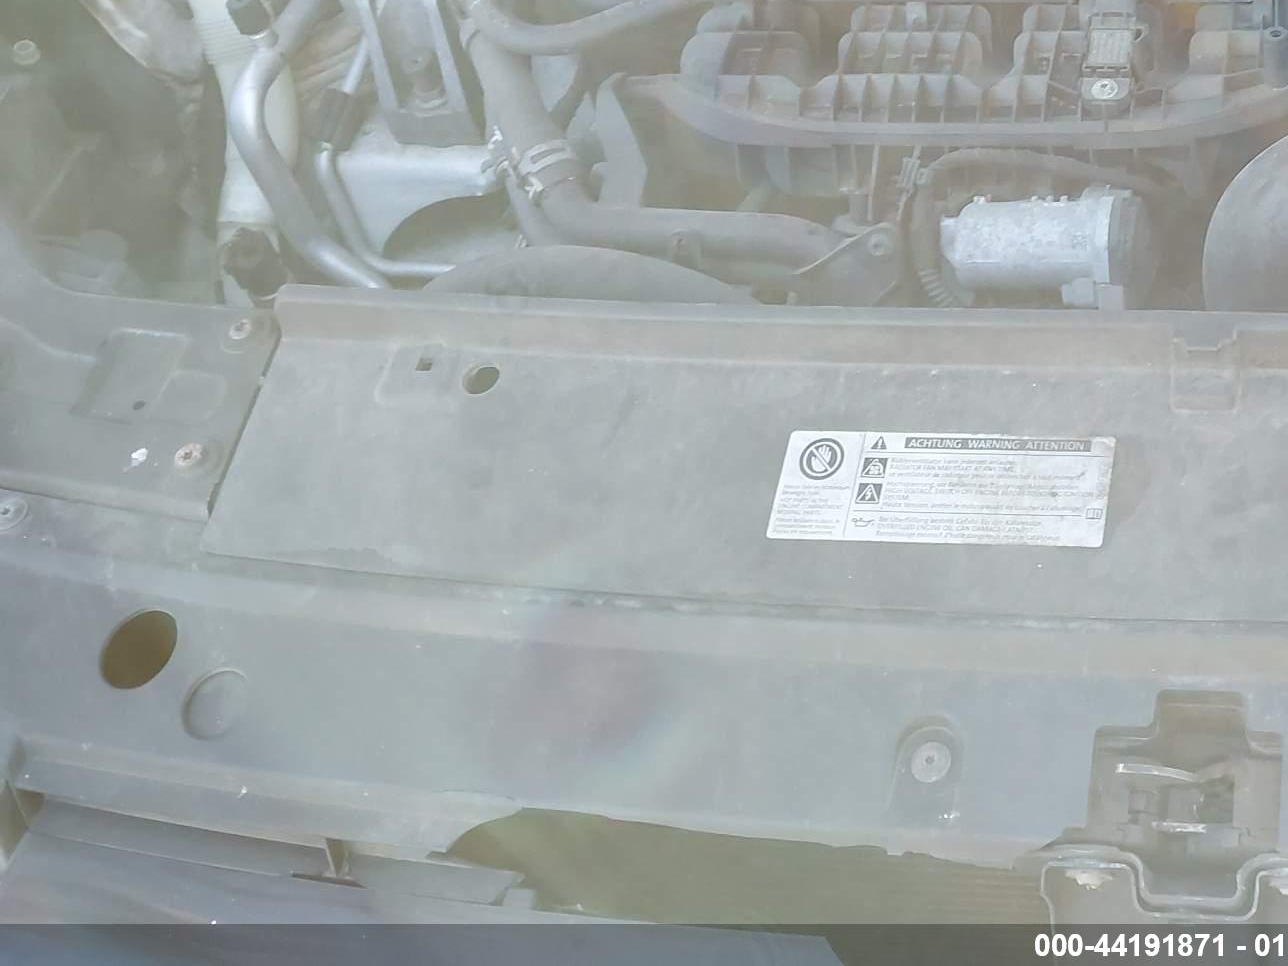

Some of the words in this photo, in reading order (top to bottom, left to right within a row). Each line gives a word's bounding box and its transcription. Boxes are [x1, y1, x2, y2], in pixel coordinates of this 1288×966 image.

[907, 439, 962, 449] ACHTUNG
[967, 439, 1020, 450] WARNING
[1024, 440, 1085, 451] ATTENTION
